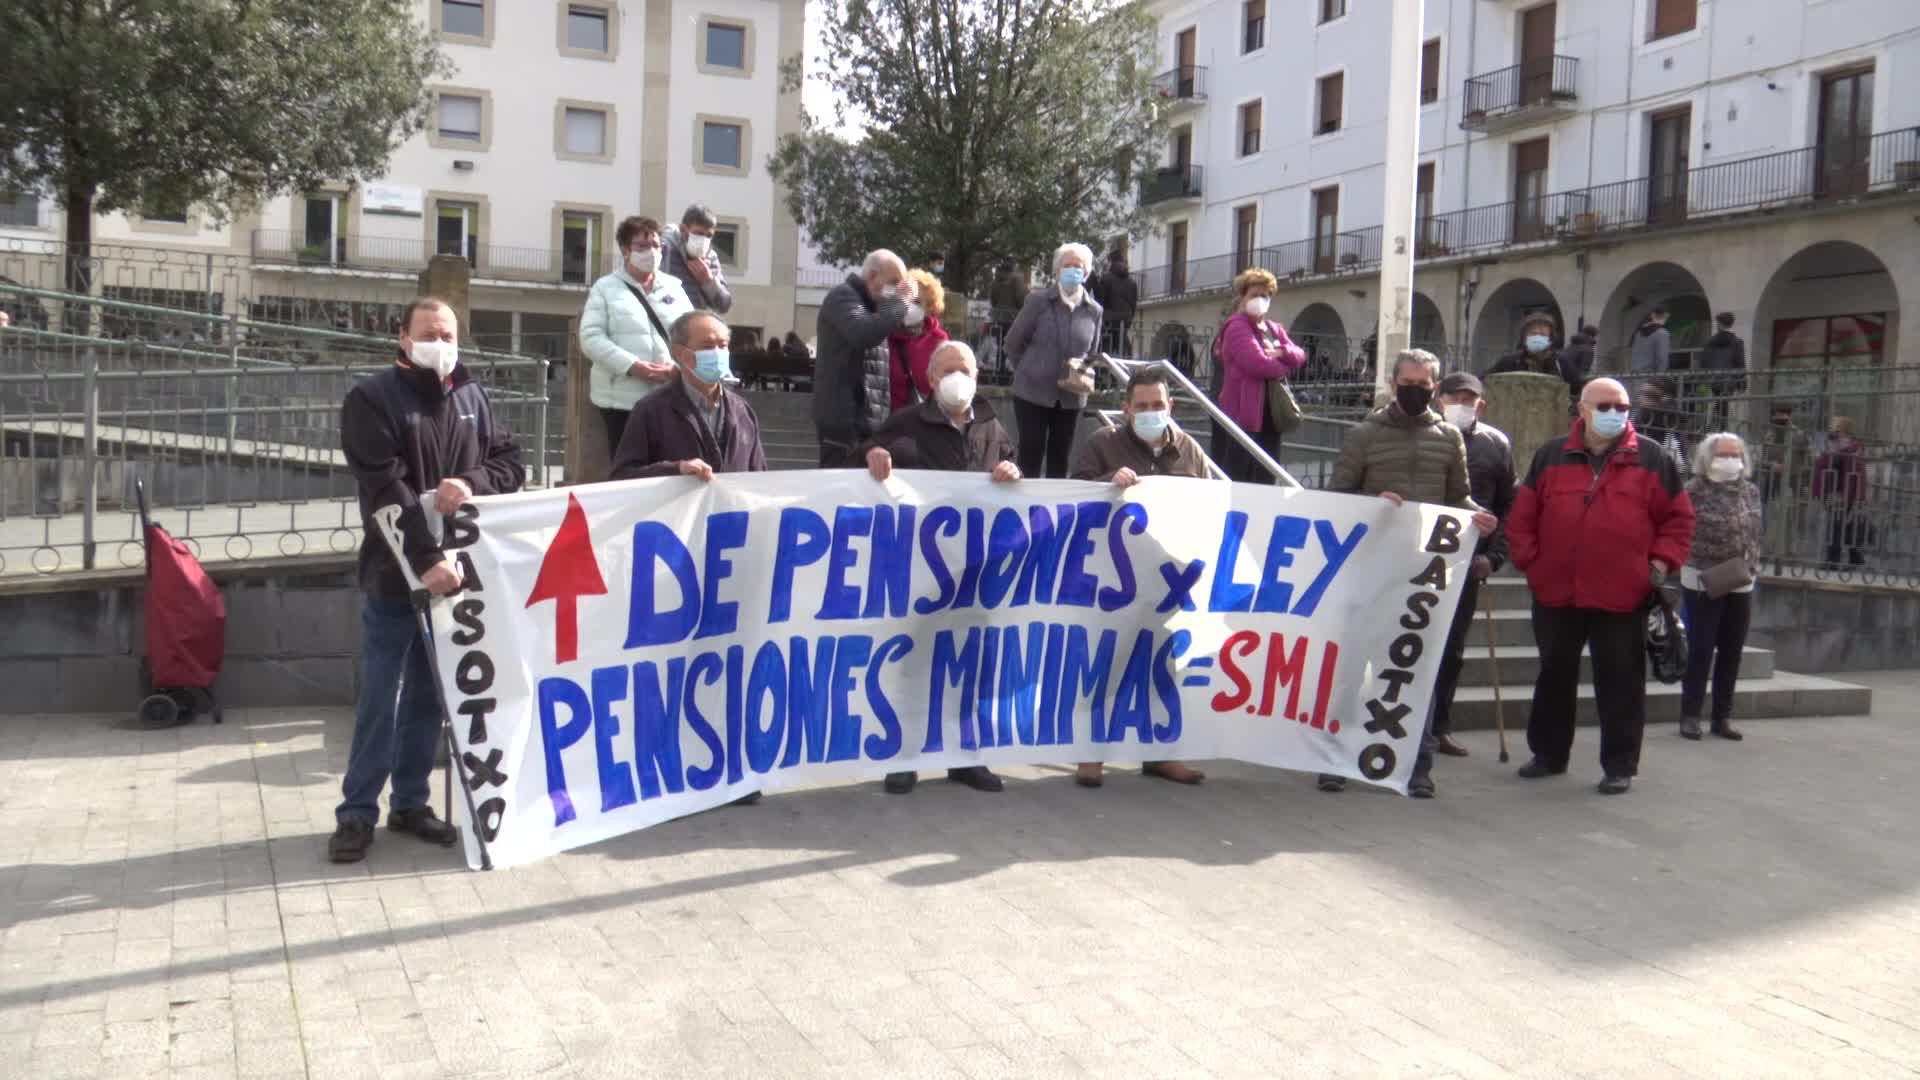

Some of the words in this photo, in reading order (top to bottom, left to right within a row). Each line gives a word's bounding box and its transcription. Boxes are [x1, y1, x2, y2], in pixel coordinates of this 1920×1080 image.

[440, 503, 509, 843] BASOTXO
[622, 510, 750, 650] DE
[766, 501, 1149, 623] PENSIONES
[1207, 510, 1368, 618] LEY
[1357, 513, 1462, 781] BASOTXO
[537, 633, 914, 827] PENSIONES
